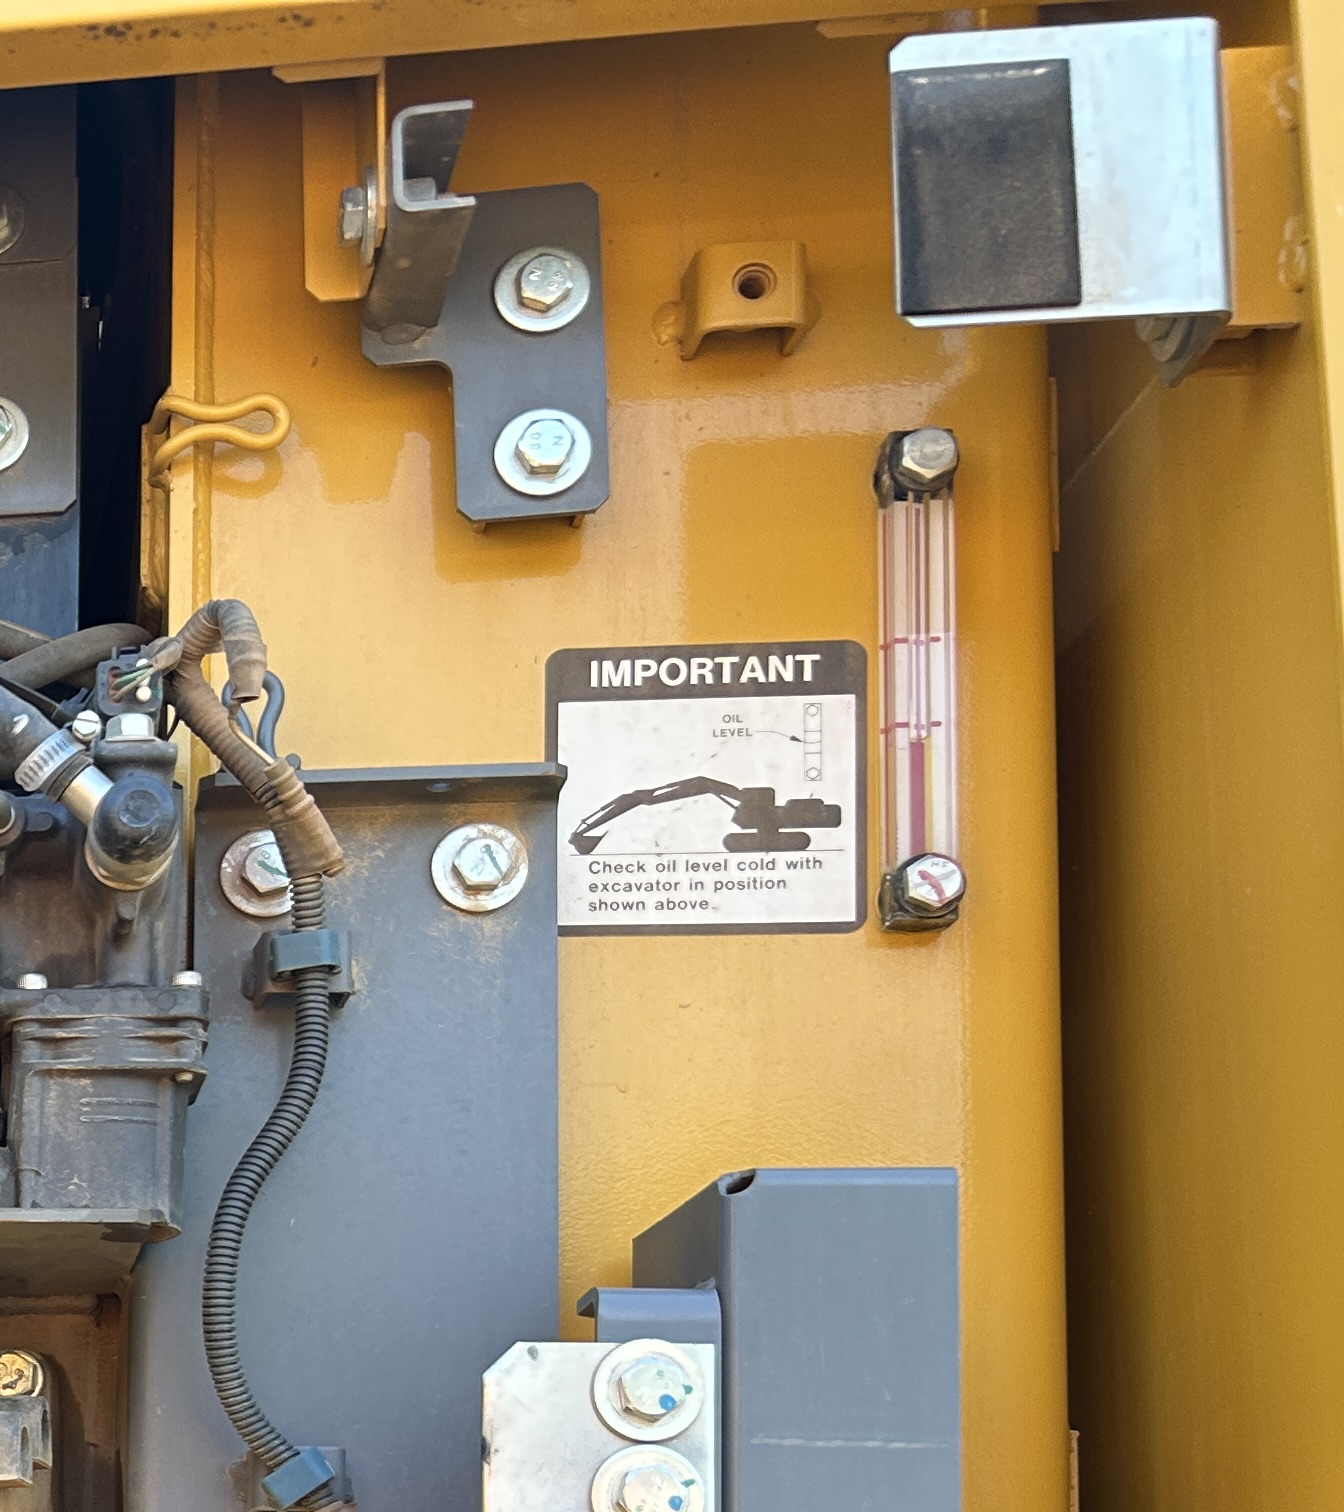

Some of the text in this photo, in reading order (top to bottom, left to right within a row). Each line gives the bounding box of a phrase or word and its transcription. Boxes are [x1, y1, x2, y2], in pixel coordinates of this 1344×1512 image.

[590, 653, 821, 688] IMPORTANT
[722, 713, 744, 725] OIL
[712, 728, 753, 738] LEVEL
[588, 856, 823, 876] Check oil level cold with
[588, 875, 788, 894] excavator in position
[588, 897, 647, 912] shown
